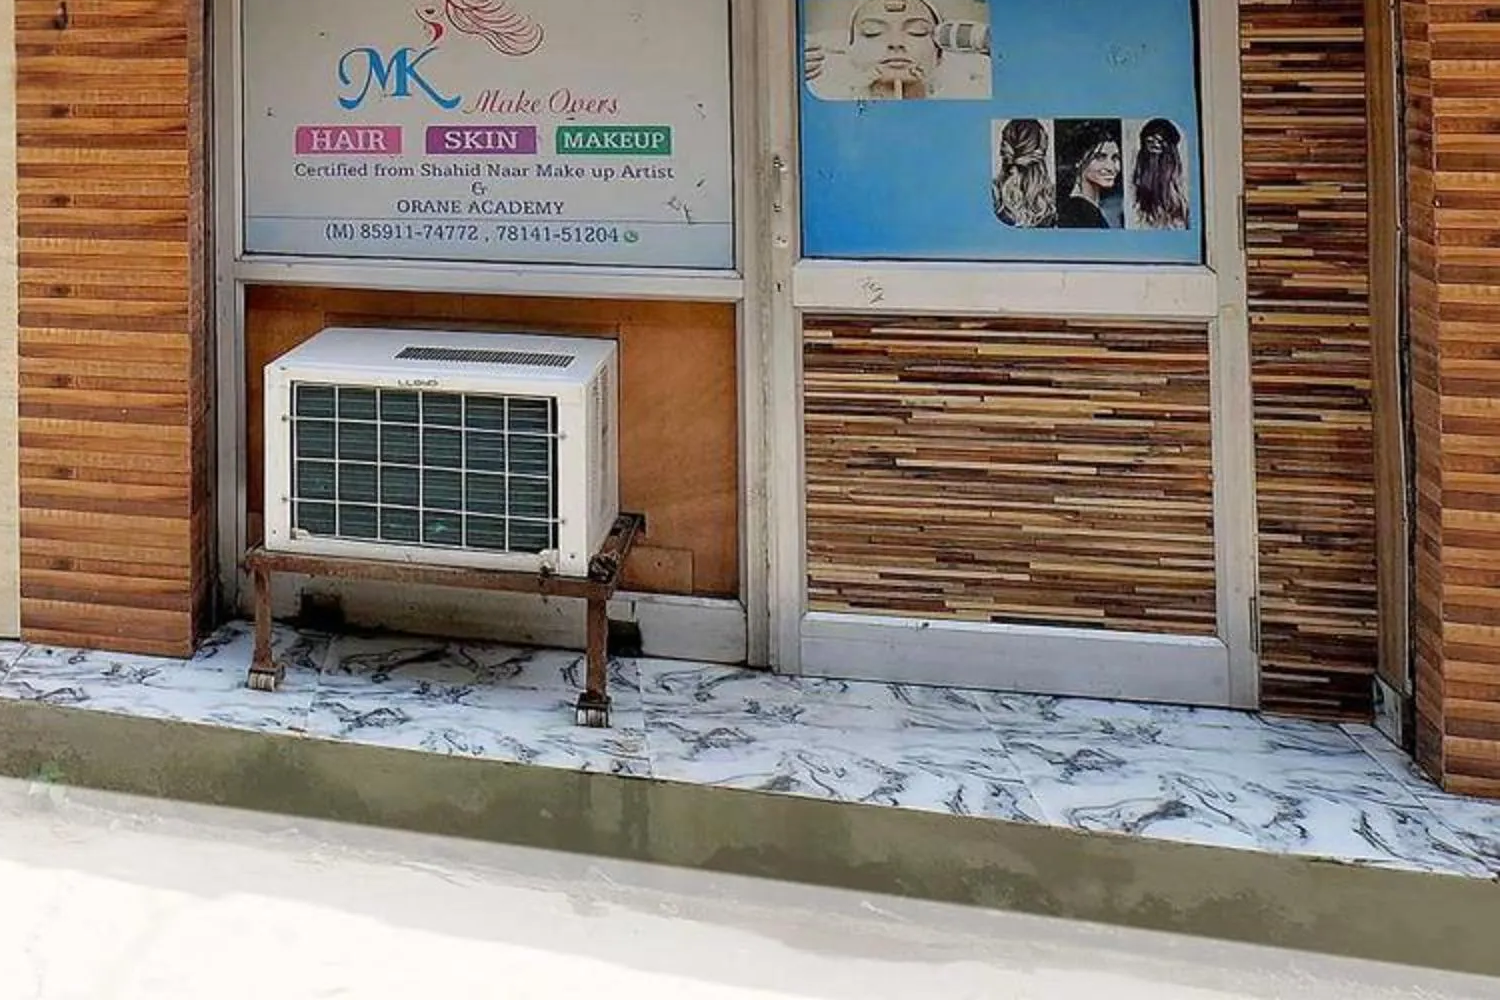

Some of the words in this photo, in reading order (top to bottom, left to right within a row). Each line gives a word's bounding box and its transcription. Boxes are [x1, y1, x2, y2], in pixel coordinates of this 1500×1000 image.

[338, 47, 462, 110] MK
[463, 88, 543, 114] Make
[549, 87, 620, 114] Overs
[311, 129, 388, 151] HAIR
[444, 131, 519, 150] SKIN
[562, 131, 666, 150] MAKEUP
[295, 163, 368, 178] Certified
[374, 163, 415, 178] from
[421, 163, 481, 178] Shahid
[487, 164, 531, 179] Naar
[536, 164, 585, 180] Make
[592, 167, 615, 181] up
[621, 164, 675, 180] Artist
[396, 199, 461, 215] ORANE
[467, 200, 565, 216] ACADEMY
[325, 223, 355, 241] (M)
[497, 224, 619, 244] 78141-51204
